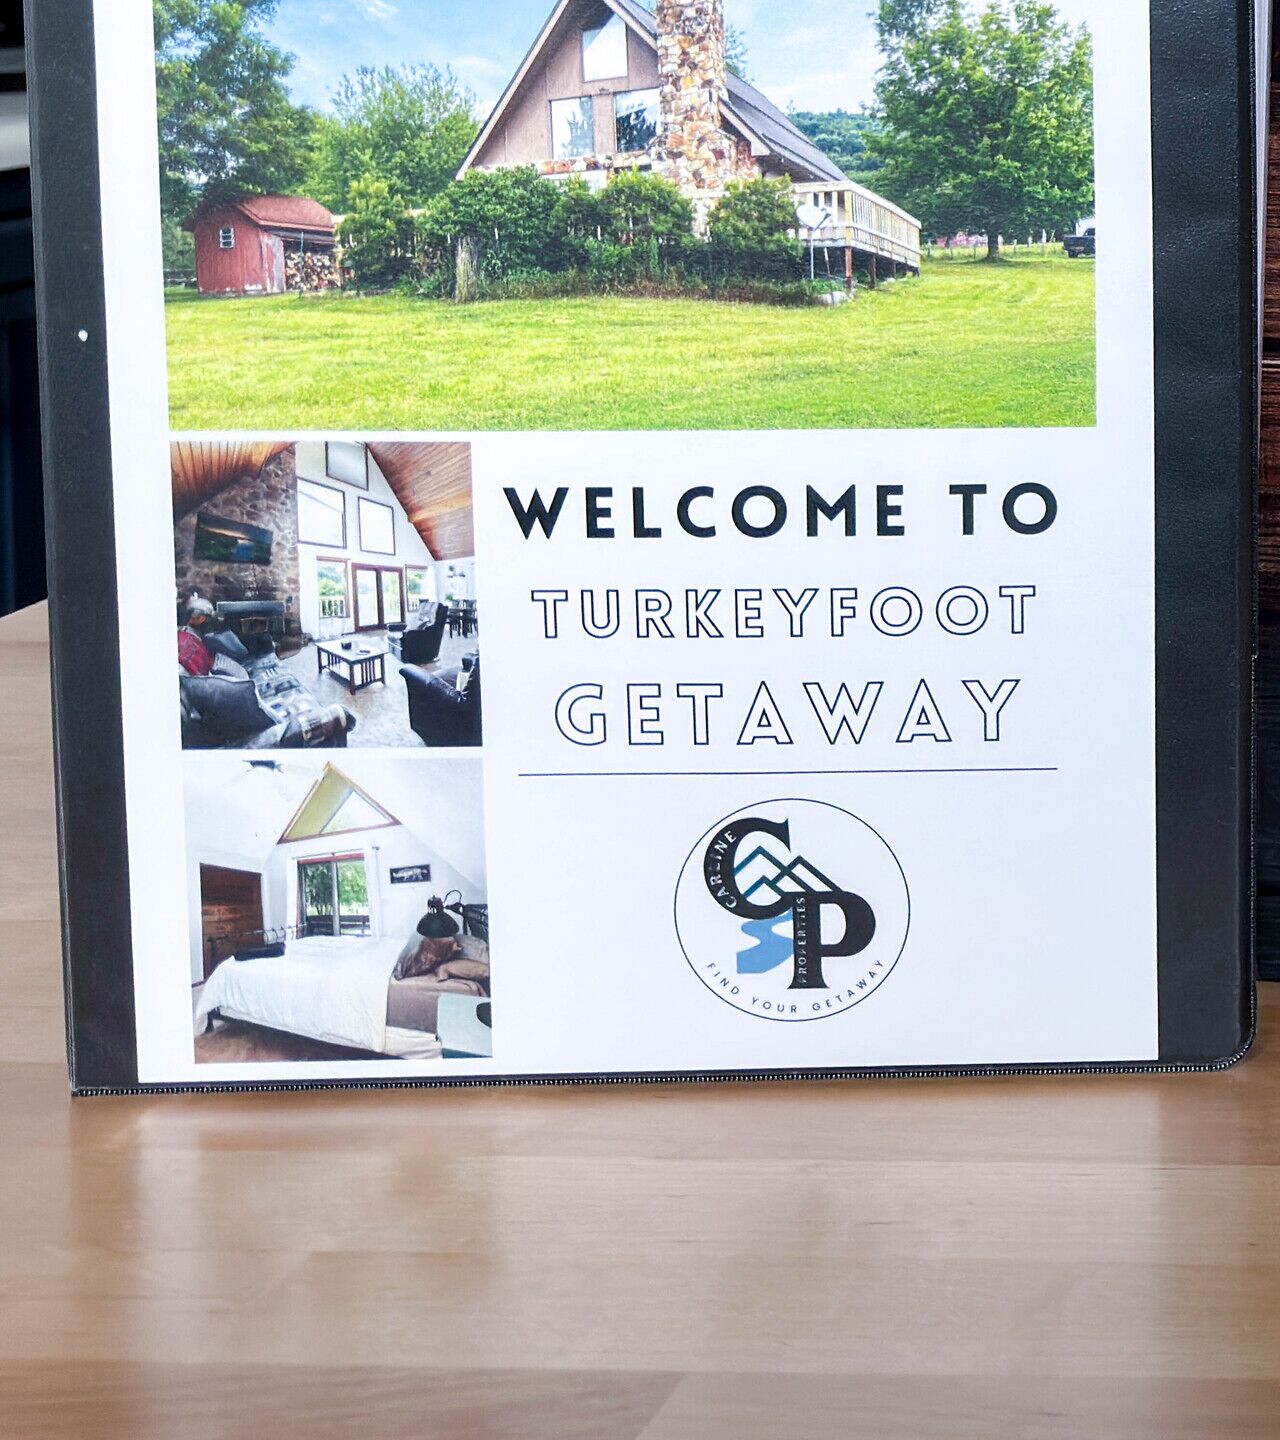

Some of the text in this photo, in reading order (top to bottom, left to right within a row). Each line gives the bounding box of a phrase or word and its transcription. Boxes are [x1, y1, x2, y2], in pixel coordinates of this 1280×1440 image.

[503, 482, 1058, 540] WELCOME TO
[531, 585, 1037, 638] TURKEYFOOT
[554, 678, 1021, 746] GETAWAY
[710, 830, 737, 909] CARLINE
[707, 959, 883, 1014] FIND YOUR GETAWAY
